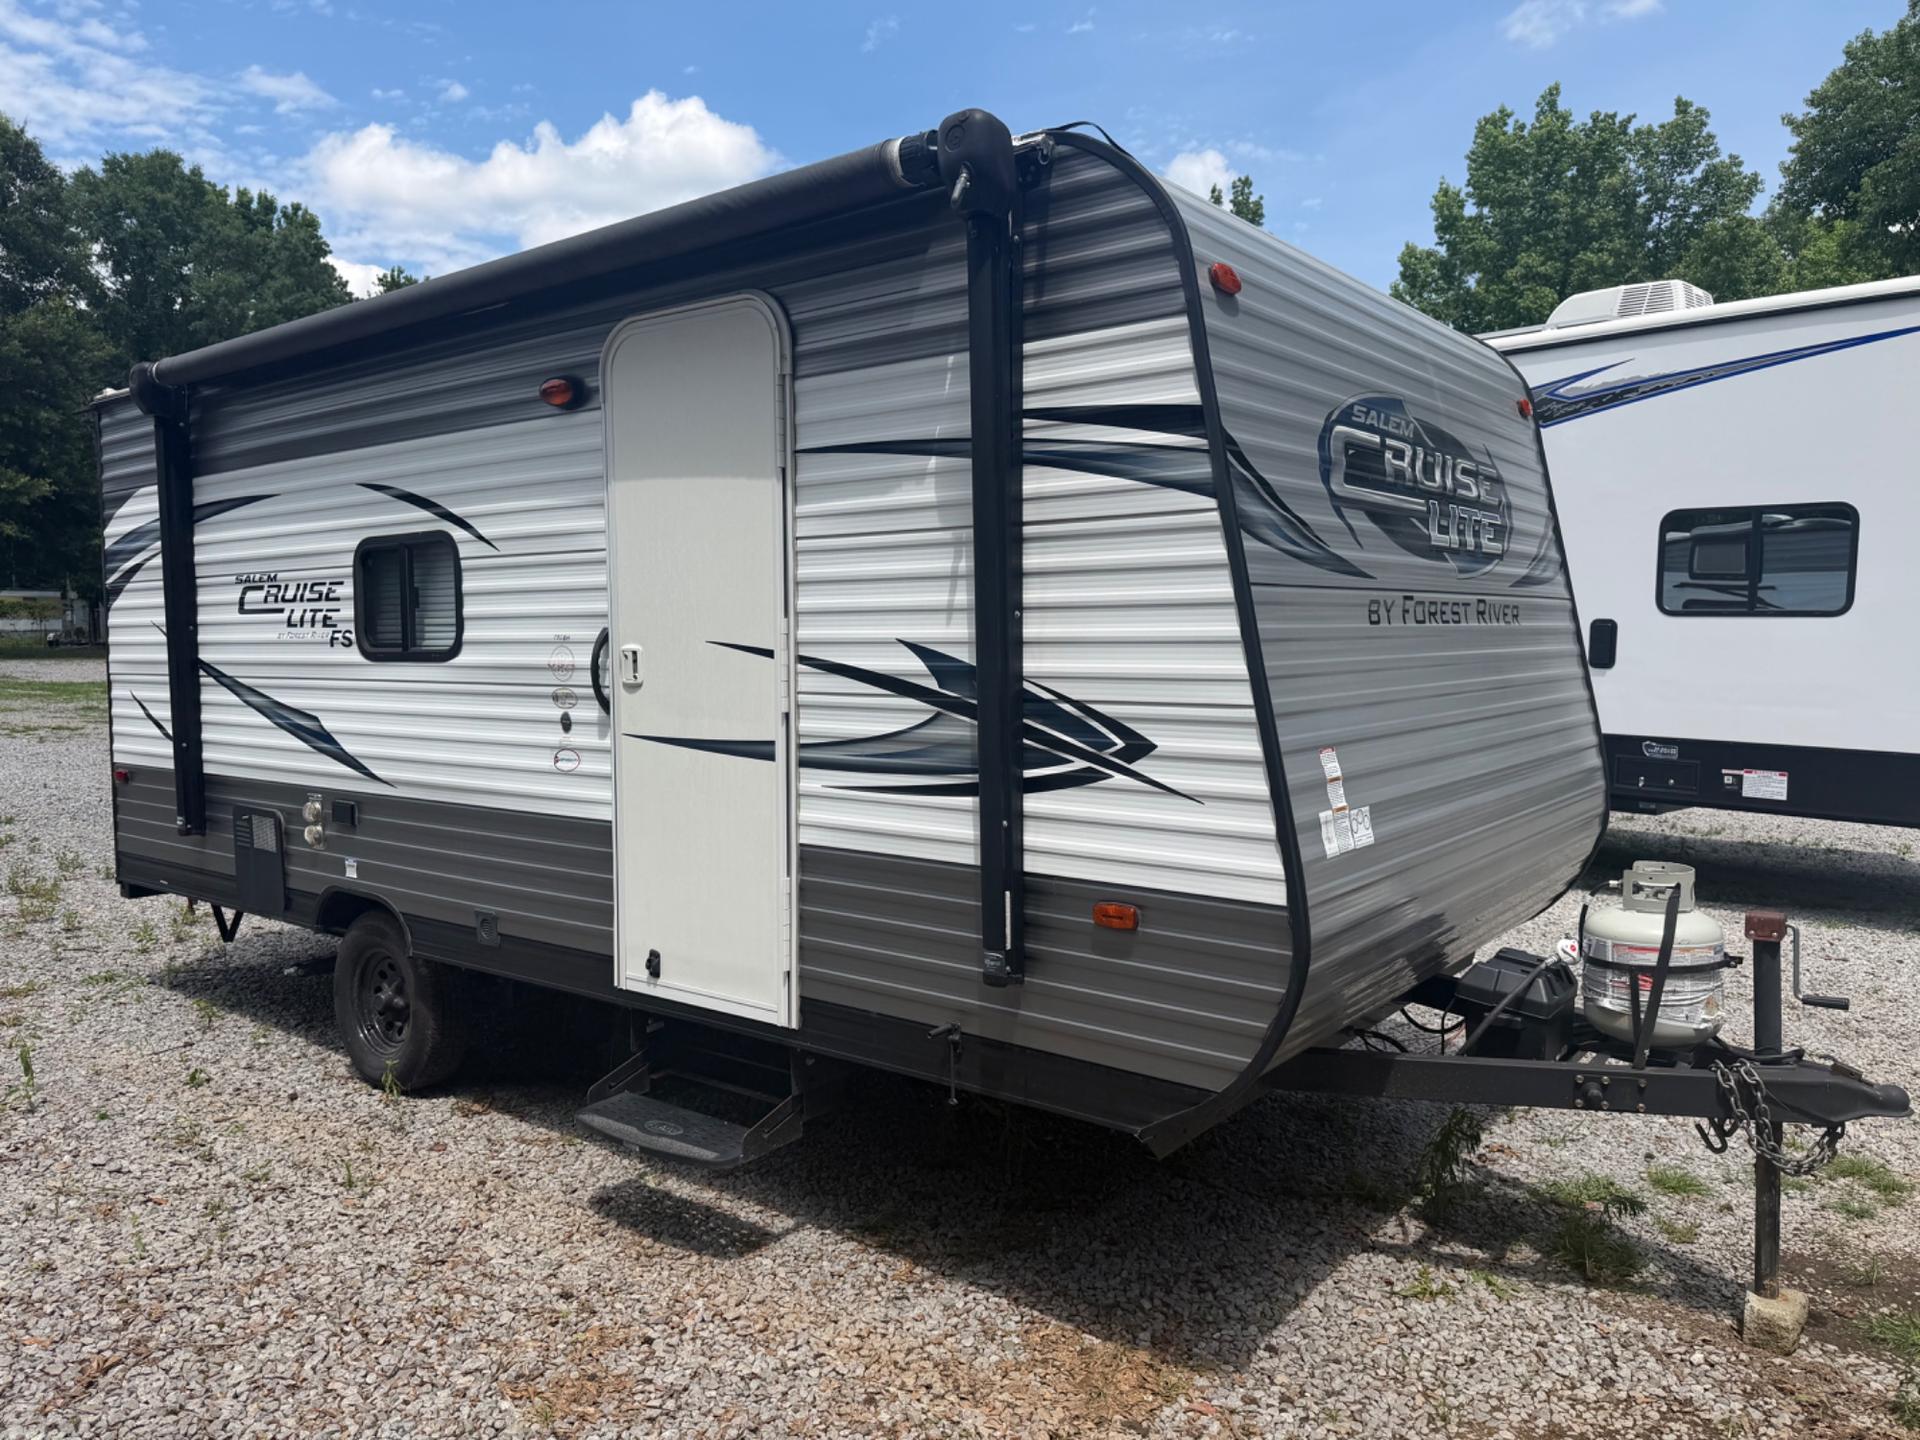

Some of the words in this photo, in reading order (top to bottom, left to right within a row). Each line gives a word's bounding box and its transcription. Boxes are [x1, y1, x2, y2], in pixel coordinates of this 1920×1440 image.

[1351, 404, 1414, 438] SALEM
[1329, 425, 1500, 512] CRUISE
[1429, 500, 1503, 554] LITE
[234, 573, 278, 584] SALEM
[238, 581, 344, 615] CRUISE
[1368, 600, 1396, 625] BY
[1402, 595, 1471, 625] FOREST
[1476, 598, 1521, 625] RIVER
[286, 608, 341, 628] LITE
[329, 629, 353, 648] FS
